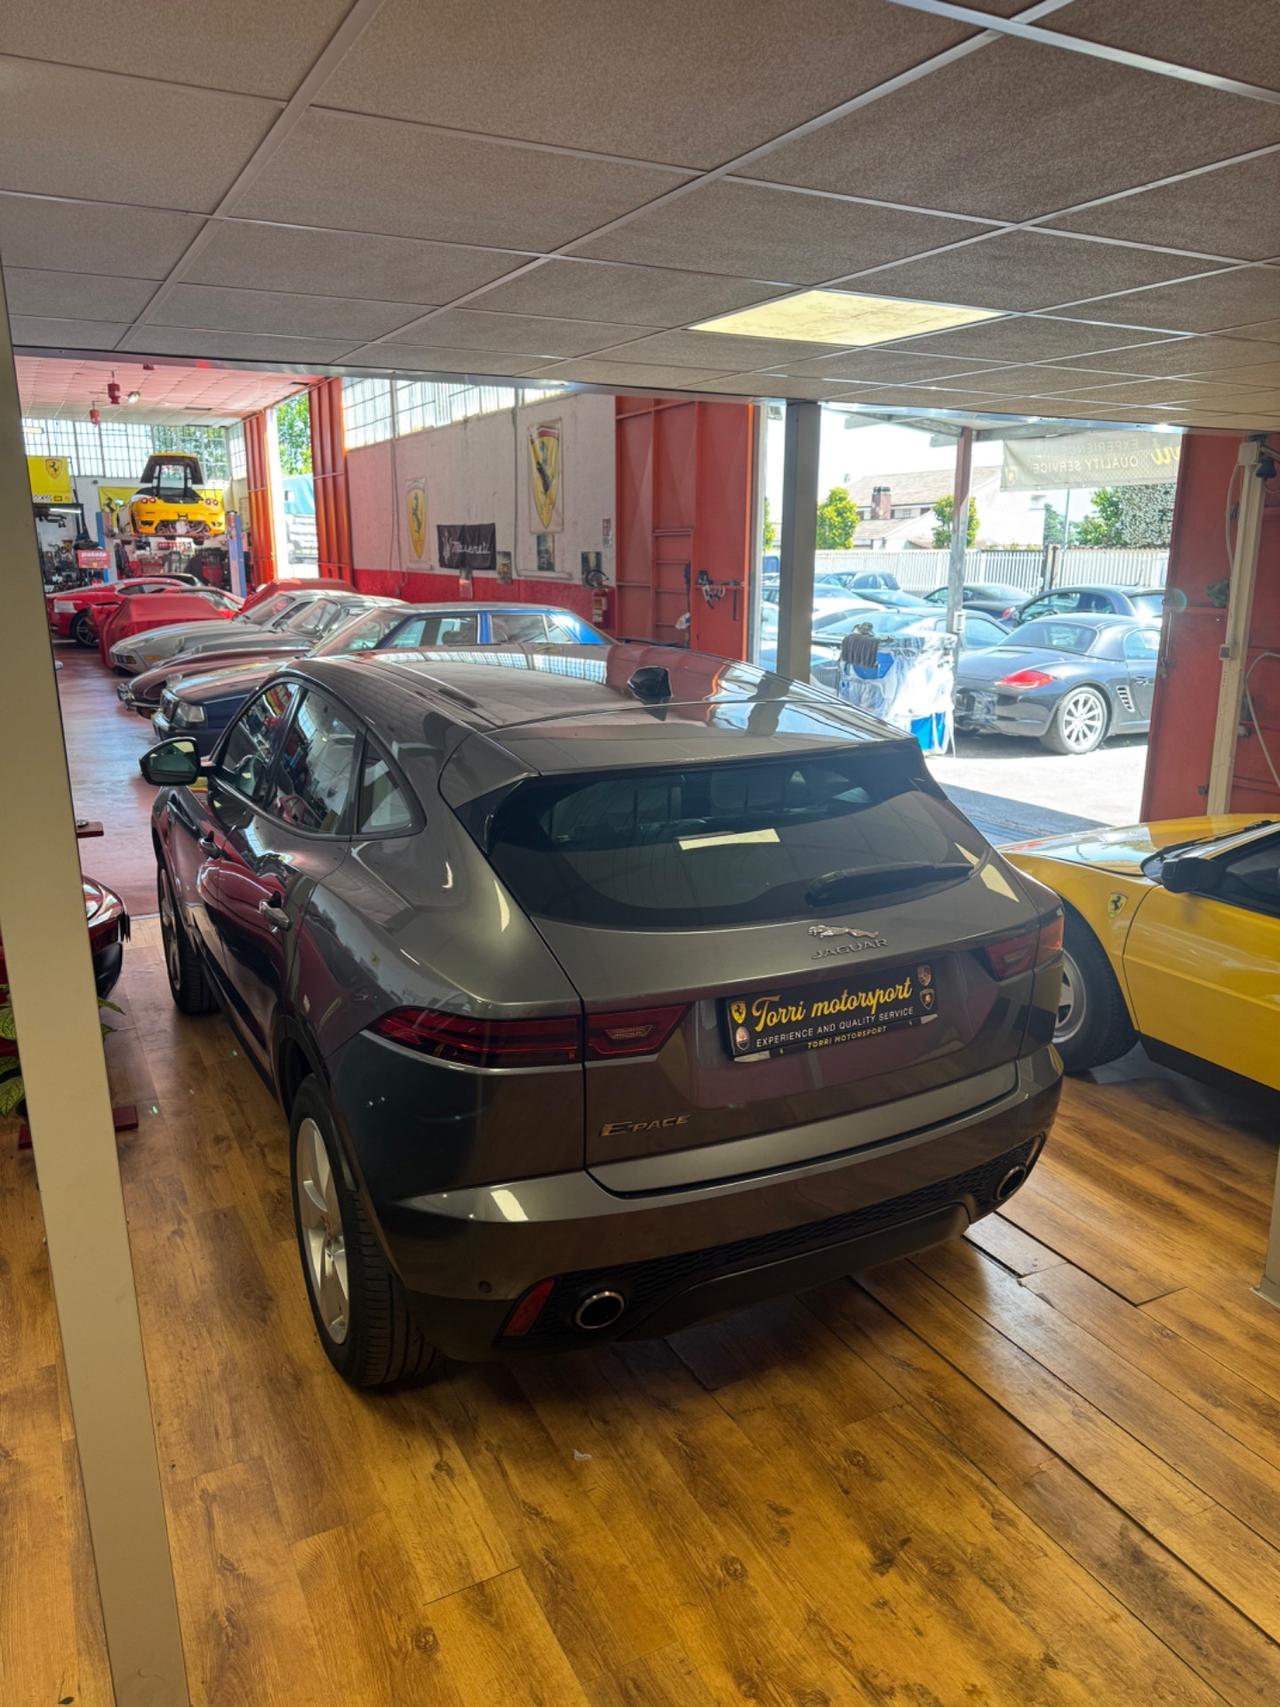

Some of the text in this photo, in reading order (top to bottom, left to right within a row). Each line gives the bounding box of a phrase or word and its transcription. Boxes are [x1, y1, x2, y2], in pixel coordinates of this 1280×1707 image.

[811, 938, 888, 960] JAGUAR
[751, 976, 913, 1032] Torri motorsport
[756, 1006, 913, 1048] EXPERIENCE AND QUALITY SERVICE
[807, 1025, 888, 1049] TORRI MOTORSPORT
